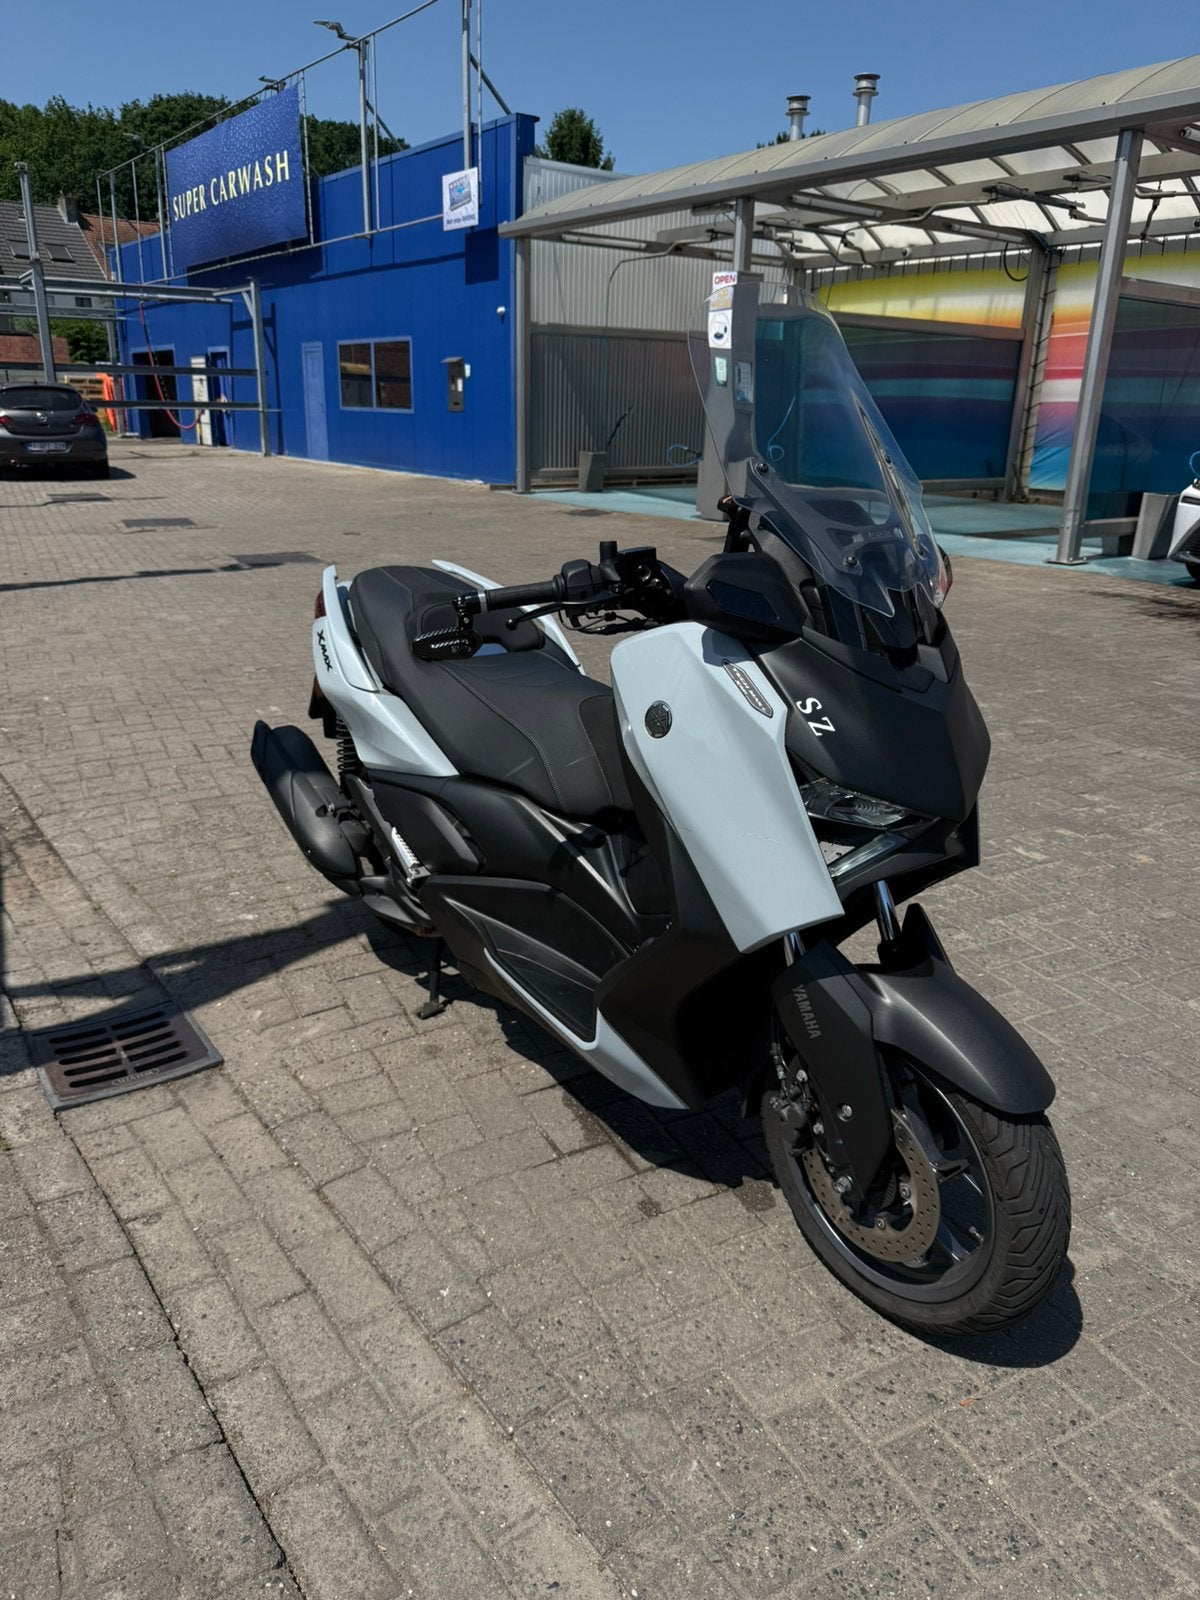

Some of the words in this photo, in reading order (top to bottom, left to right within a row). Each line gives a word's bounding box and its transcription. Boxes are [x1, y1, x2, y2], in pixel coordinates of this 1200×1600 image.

[172, 184, 207, 222] SUPER
[210, 150, 290, 206] CARWASH
[714, 274, 736, 285] OPEN
[791, 983, 823, 1039] YAMAHA
